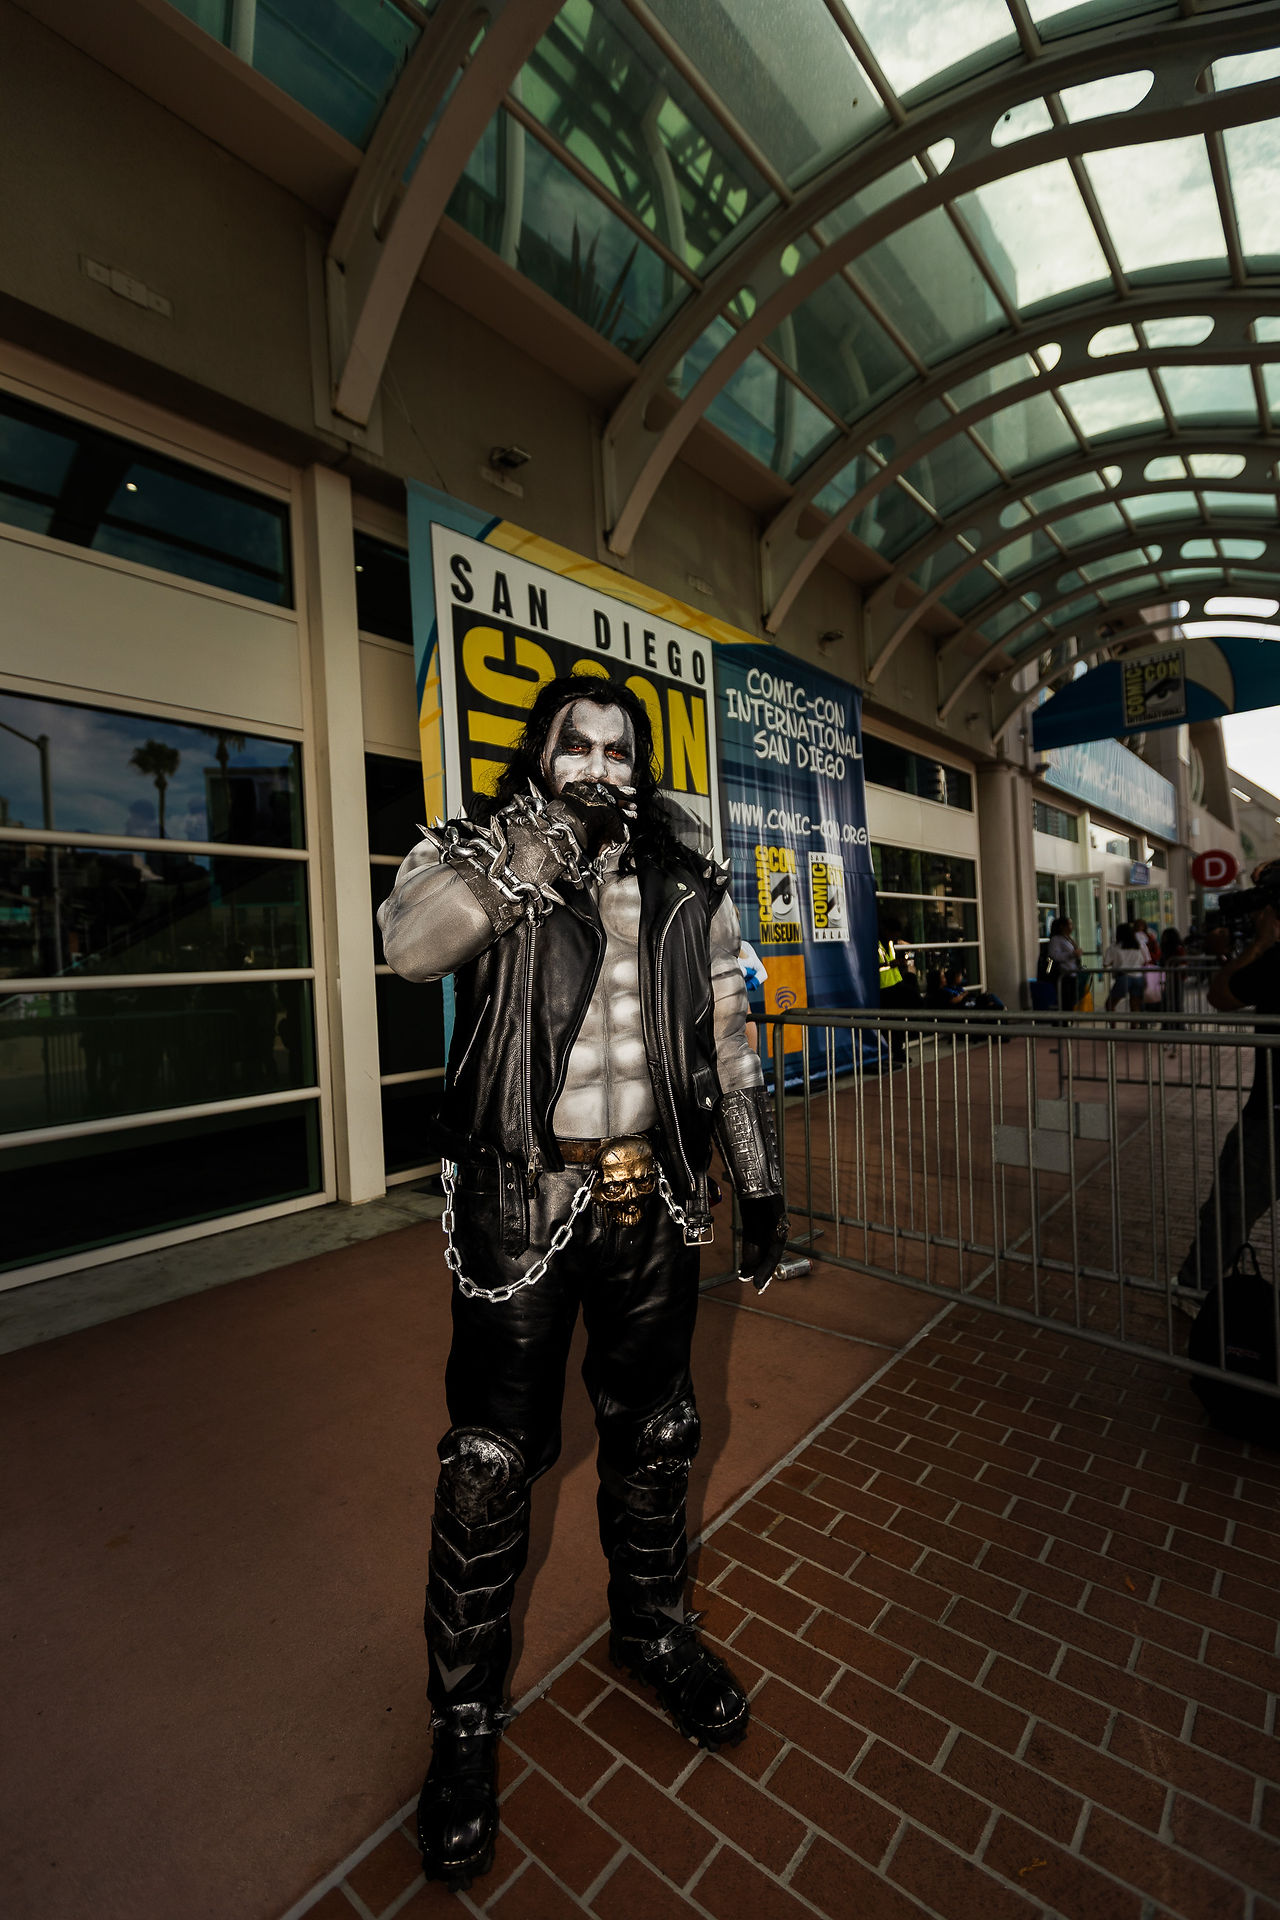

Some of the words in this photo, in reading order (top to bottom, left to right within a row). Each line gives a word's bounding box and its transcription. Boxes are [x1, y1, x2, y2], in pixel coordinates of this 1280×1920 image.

[450, 553, 550, 631] SAN
[593, 608, 706, 686] DIEGO
[1125, 667, 1146, 717] COMIC
[1144, 658, 1181, 681] CON
[726, 688, 863, 760] INTERNATIONAL
[747, 667, 845, 729] COMIC-CON
[753, 729, 790, 765] SAN
[797, 743, 846, 781] DIEGO
[755, 845, 773, 922] COMIC
[768, 846, 796, 874] CON
[1204, 857, 1227, 881] D
[812, 863, 828, 929] COMIC
[760, 922, 802, 943] MUSEUM
